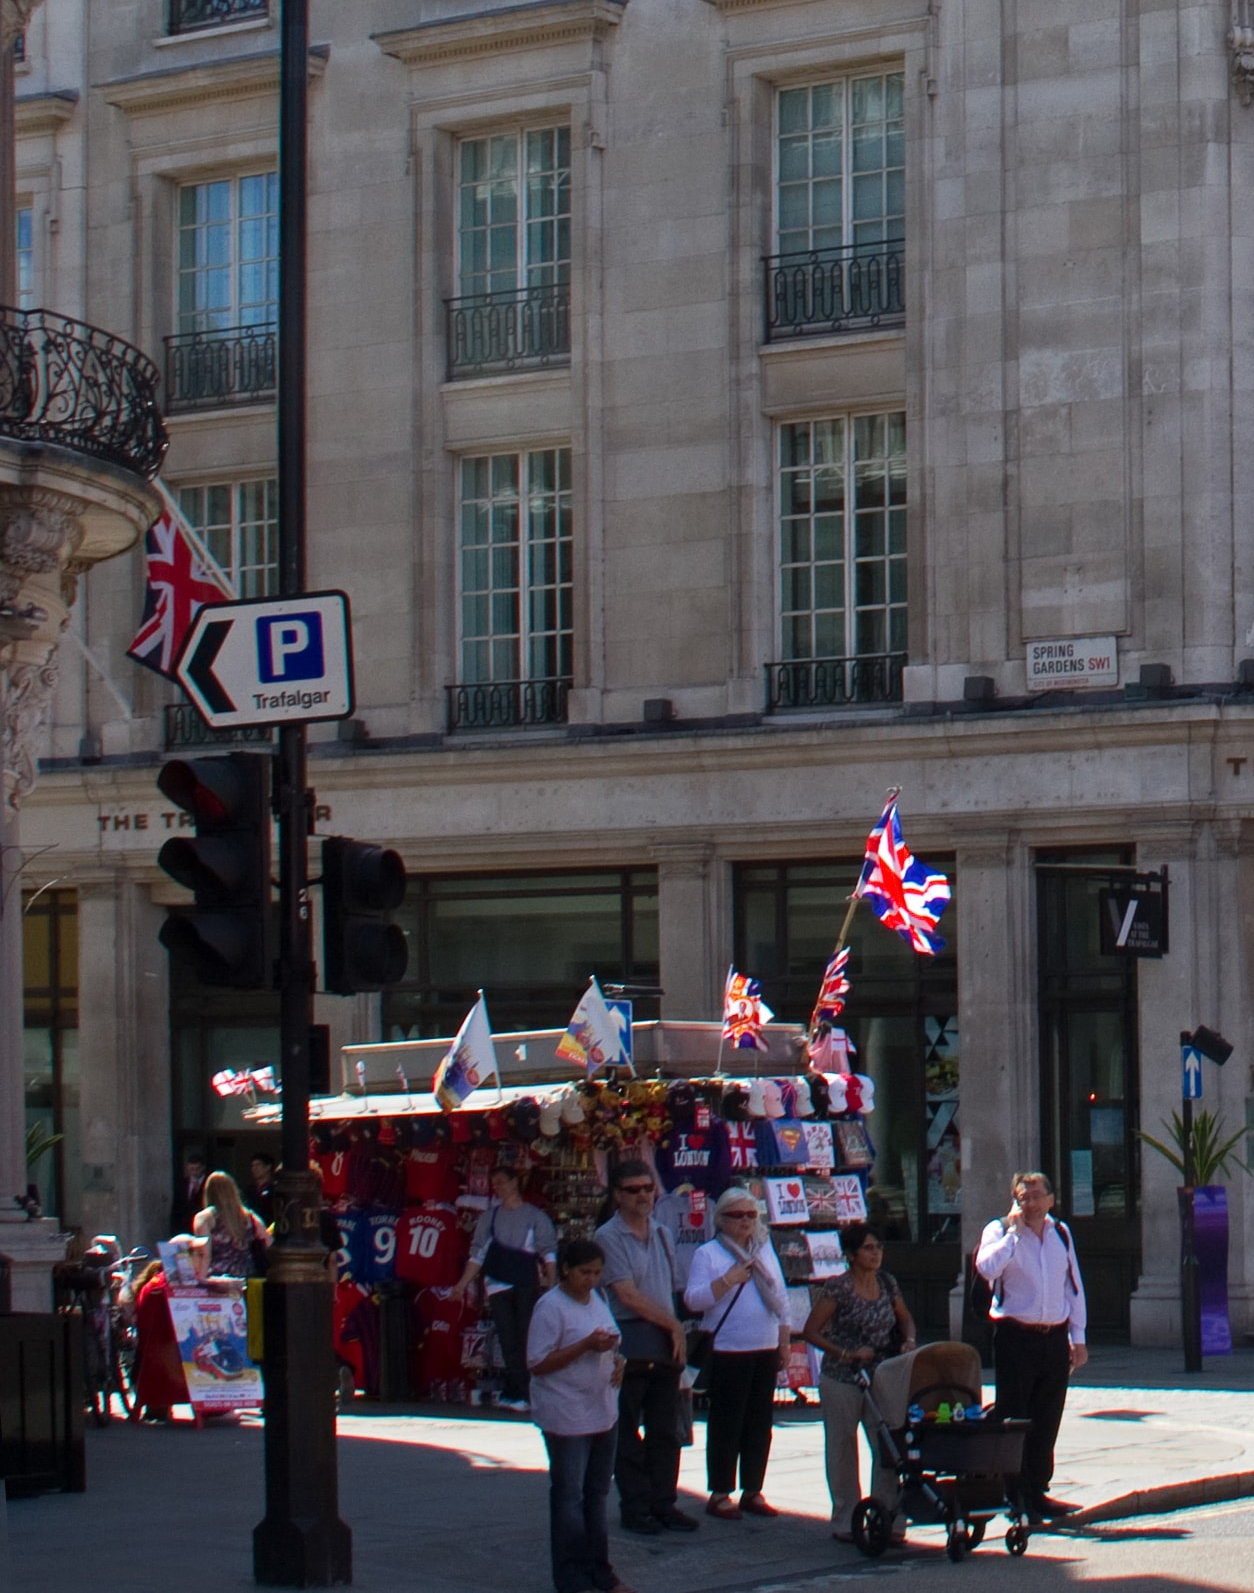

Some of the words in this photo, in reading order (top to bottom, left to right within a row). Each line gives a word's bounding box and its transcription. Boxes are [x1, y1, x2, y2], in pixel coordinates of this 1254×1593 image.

[270, 619, 309, 676] P
[1033, 644, 1074, 660] SPRING
[1033, 658, 1085, 675] GARDENS
[1088, 656, 1110, 671] SW1
[252, 690, 331, 710] Trafalgar
[97, 814, 149, 832] THE
[678, 1133, 688, 1150] I
[674, 1150, 711, 1167] LONDON
[776, 1184, 785, 1199] I
[778, 1199, 806, 1215] LONDON
[408, 1215, 447, 1232] ROONEY
[374, 1226, 397, 1264] 9
[408, 1225, 440, 1258] 10
[676, 1228, 706, 1245] LONDON
